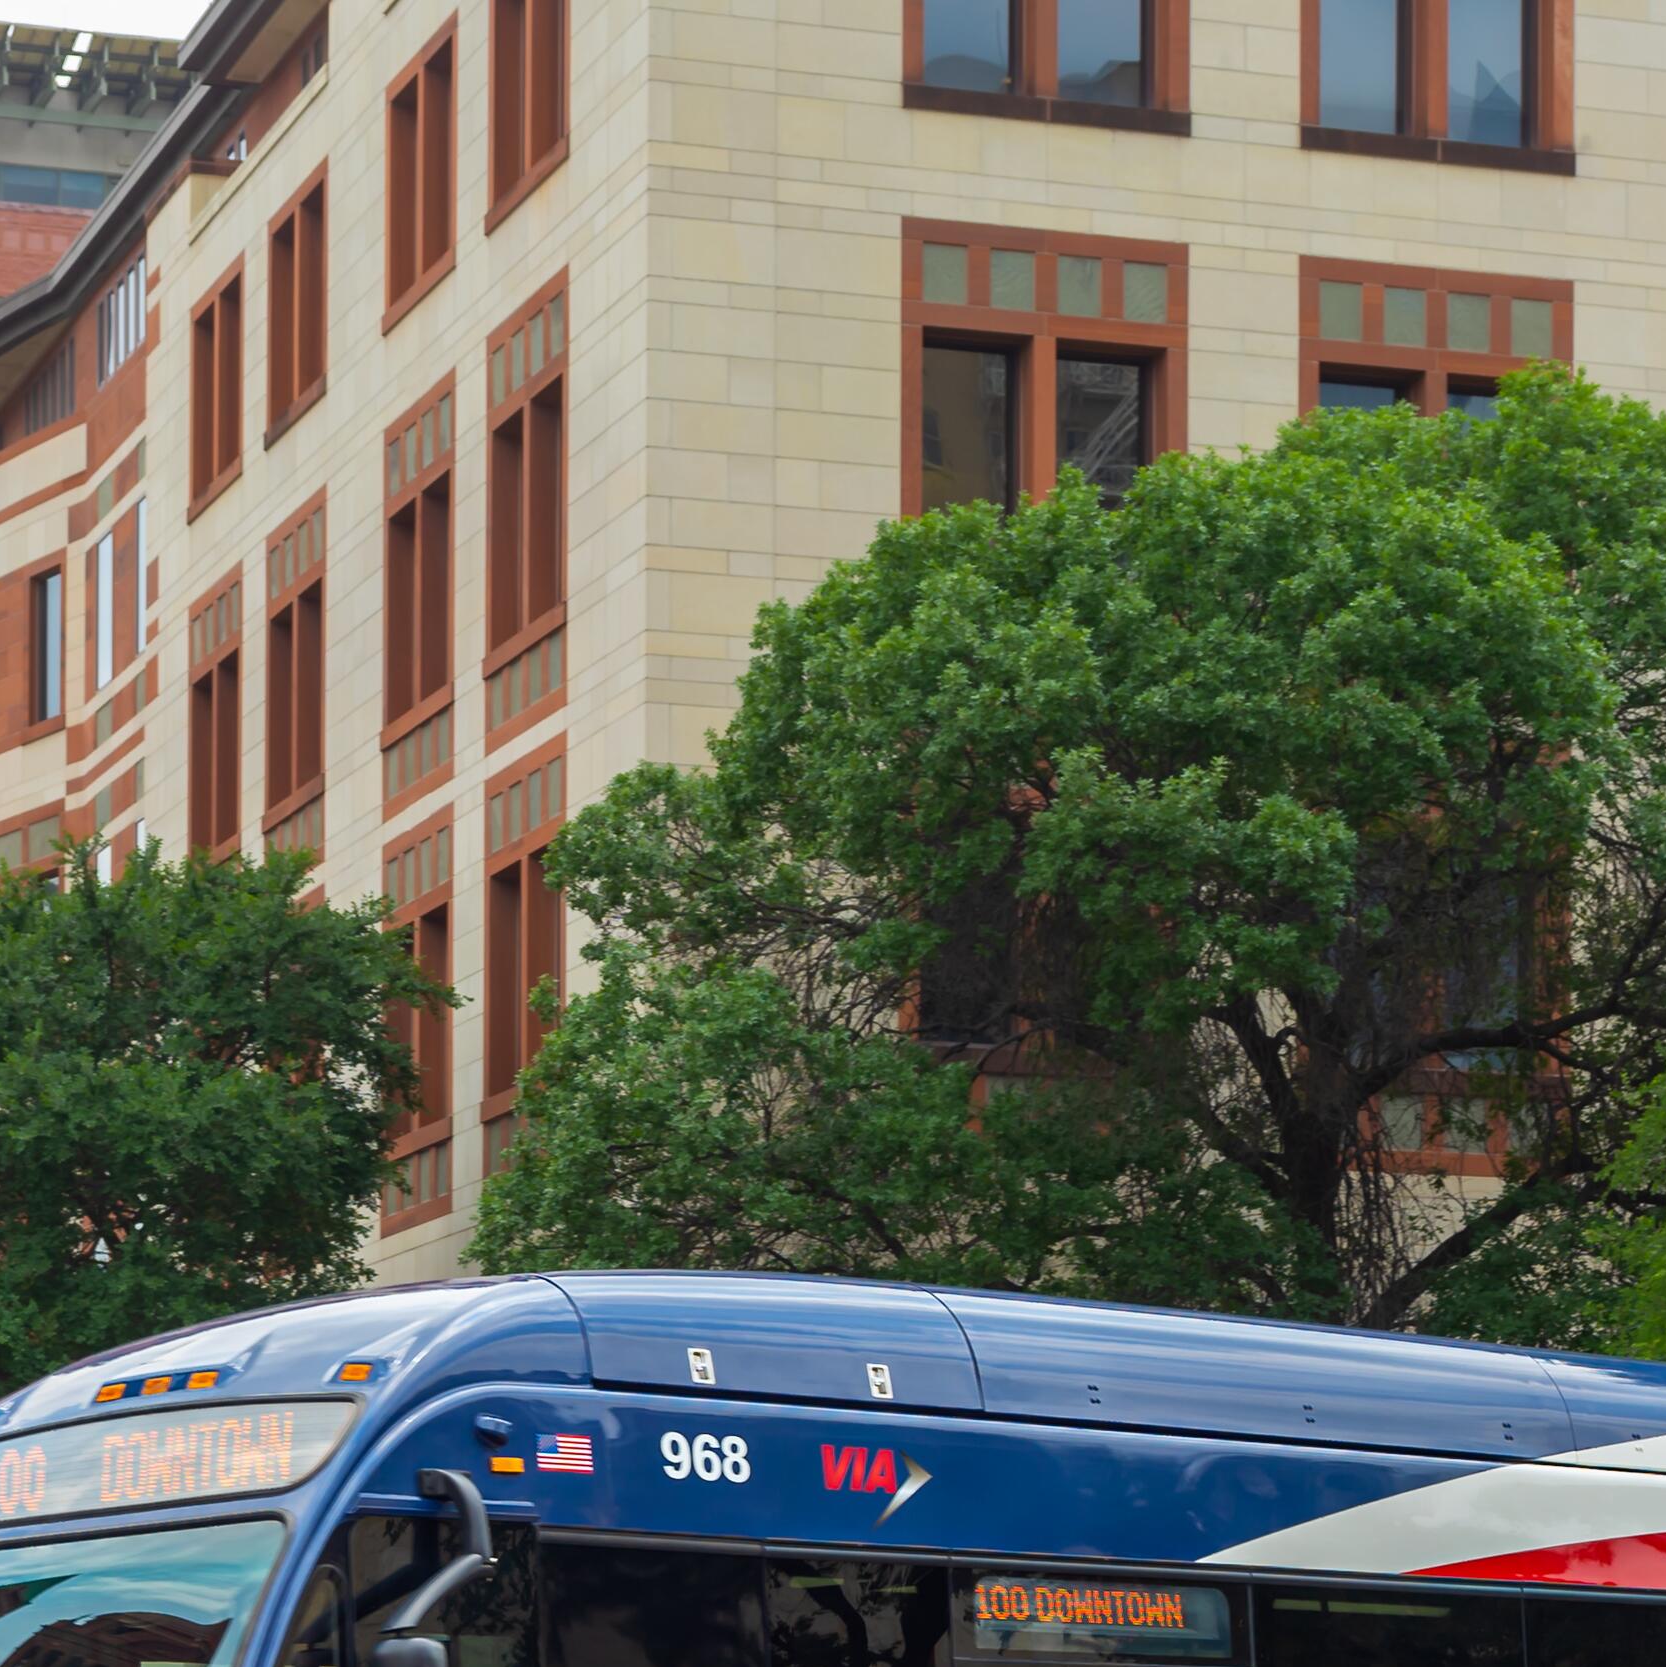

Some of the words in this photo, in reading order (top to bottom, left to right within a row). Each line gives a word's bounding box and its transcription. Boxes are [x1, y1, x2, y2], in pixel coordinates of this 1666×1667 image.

[101, 1411, 294, 1501] DOWNTOWN
[660, 1431, 751, 1483] 968
[820, 1444, 898, 1494] VIA
[975, 1584, 1030, 1621] 100
[1035, 1587, 1184, 1628] DOWNTOWN
